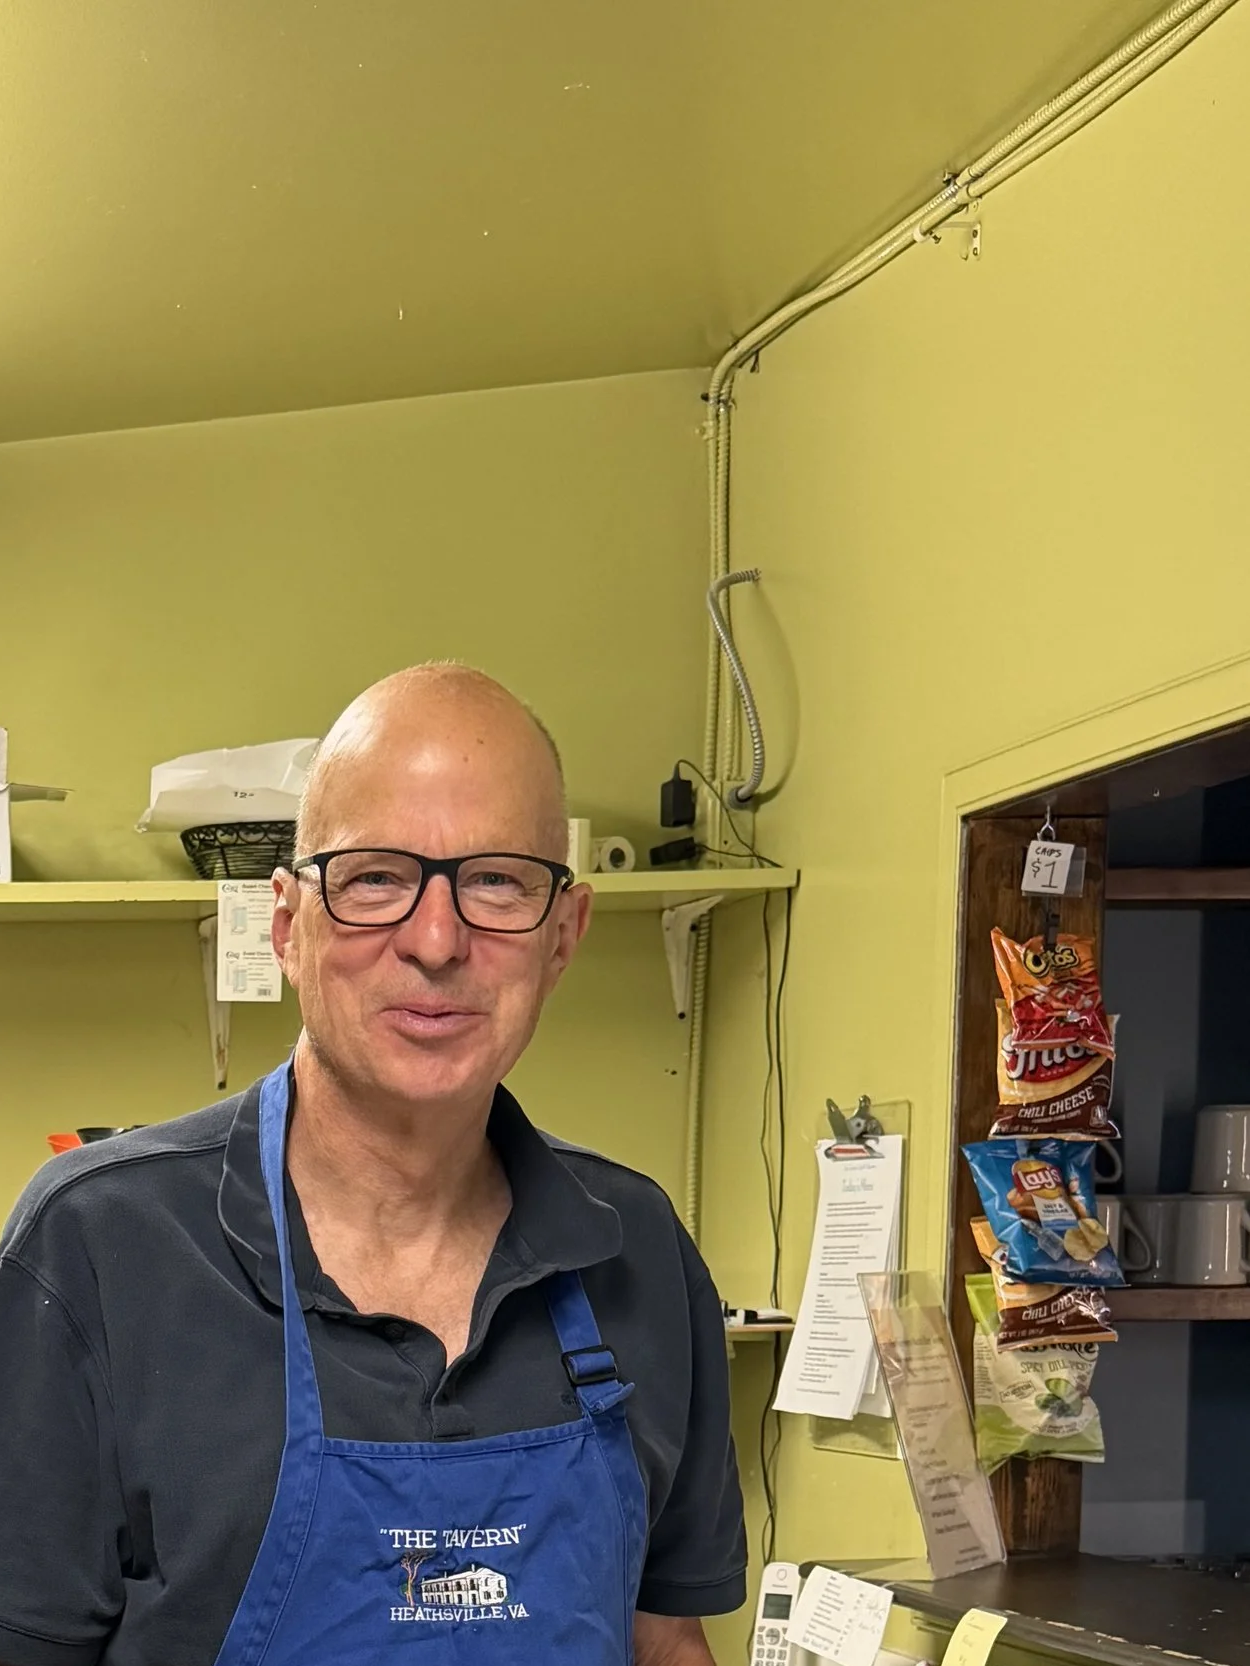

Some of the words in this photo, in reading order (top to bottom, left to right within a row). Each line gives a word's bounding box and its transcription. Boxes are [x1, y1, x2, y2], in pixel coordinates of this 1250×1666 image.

[1031, 857, 1059, 889] $1
[1017, 1105, 1046, 1119] CHILI
[1048, 1086, 1096, 1116] CHEESE
[1016, 1166, 1062, 1191] Lay's
